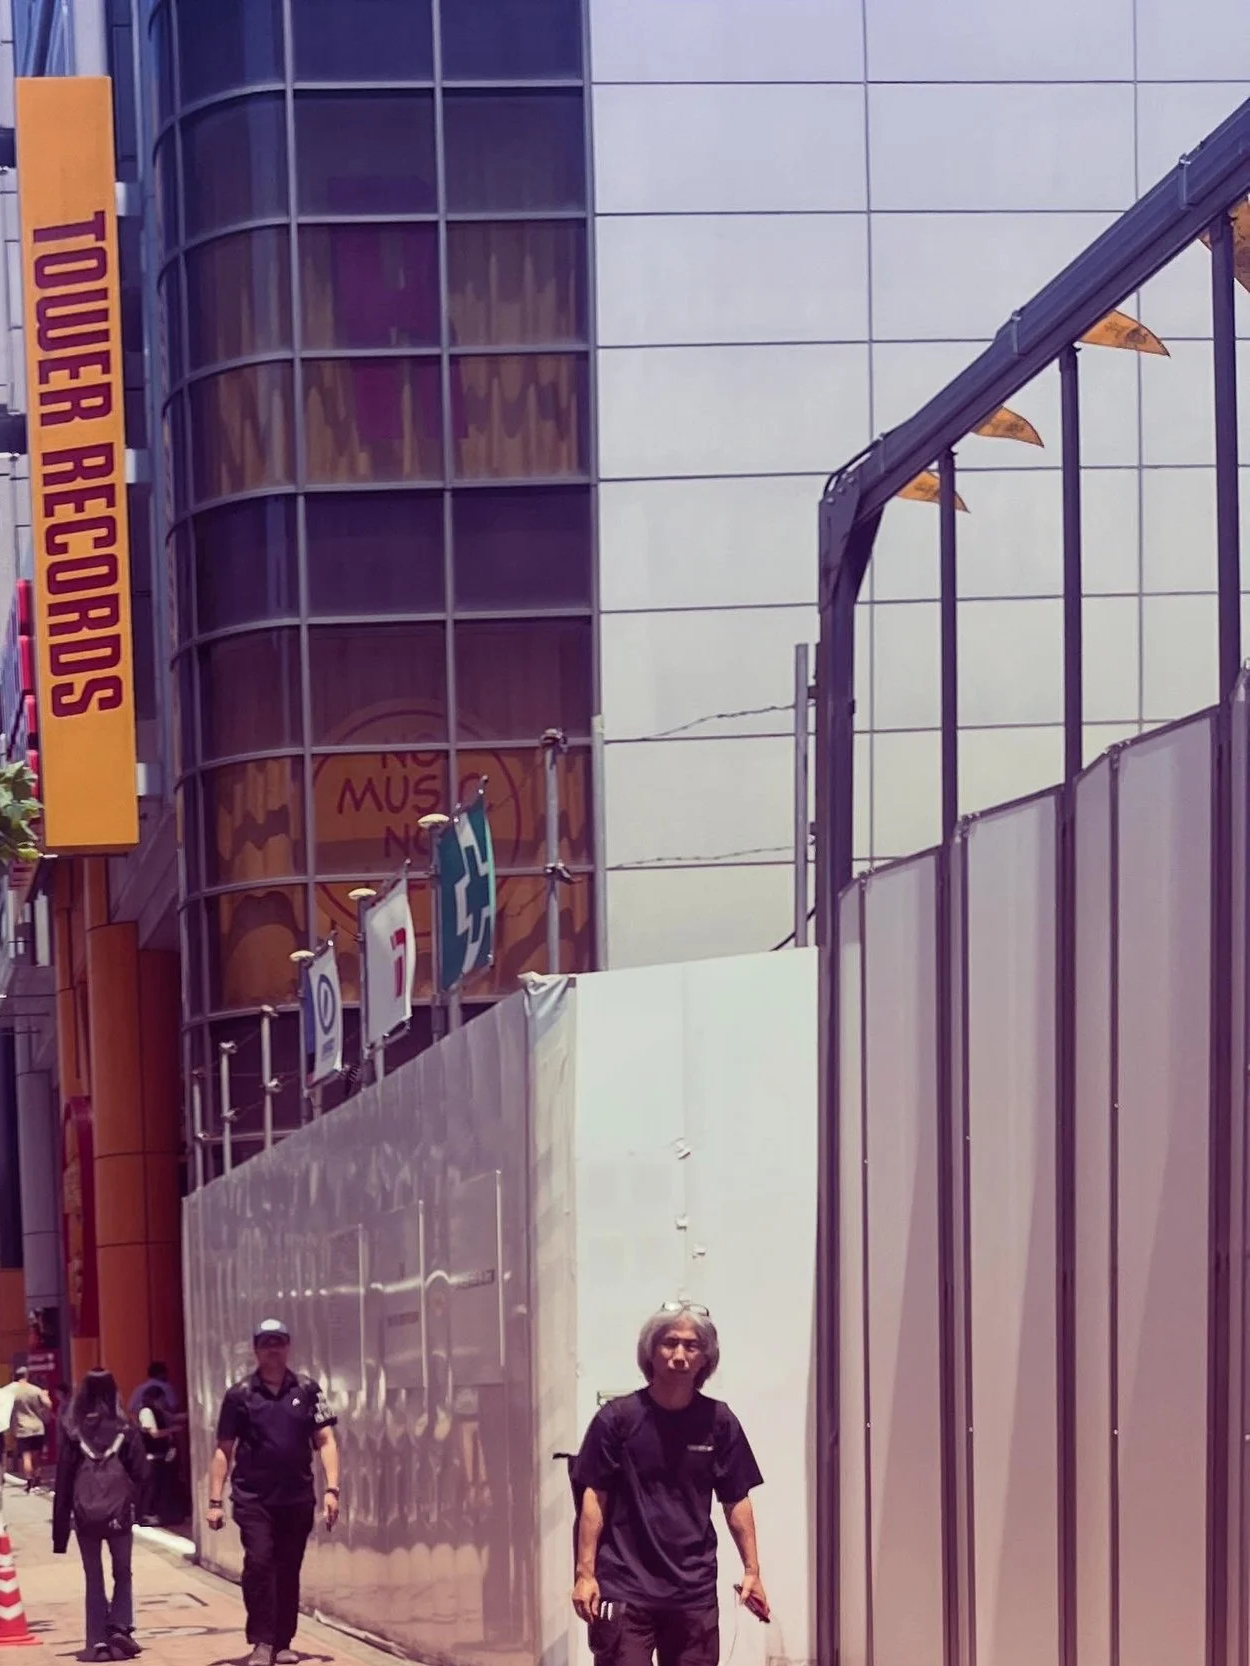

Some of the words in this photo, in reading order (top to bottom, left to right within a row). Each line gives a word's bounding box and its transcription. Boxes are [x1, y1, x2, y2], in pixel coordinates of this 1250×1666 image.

[33, 210, 112, 427] TOWER
[41, 441, 124, 718] RECORDS
[337, 772, 493, 815] MUSC
[380, 732, 442, 769] NO
